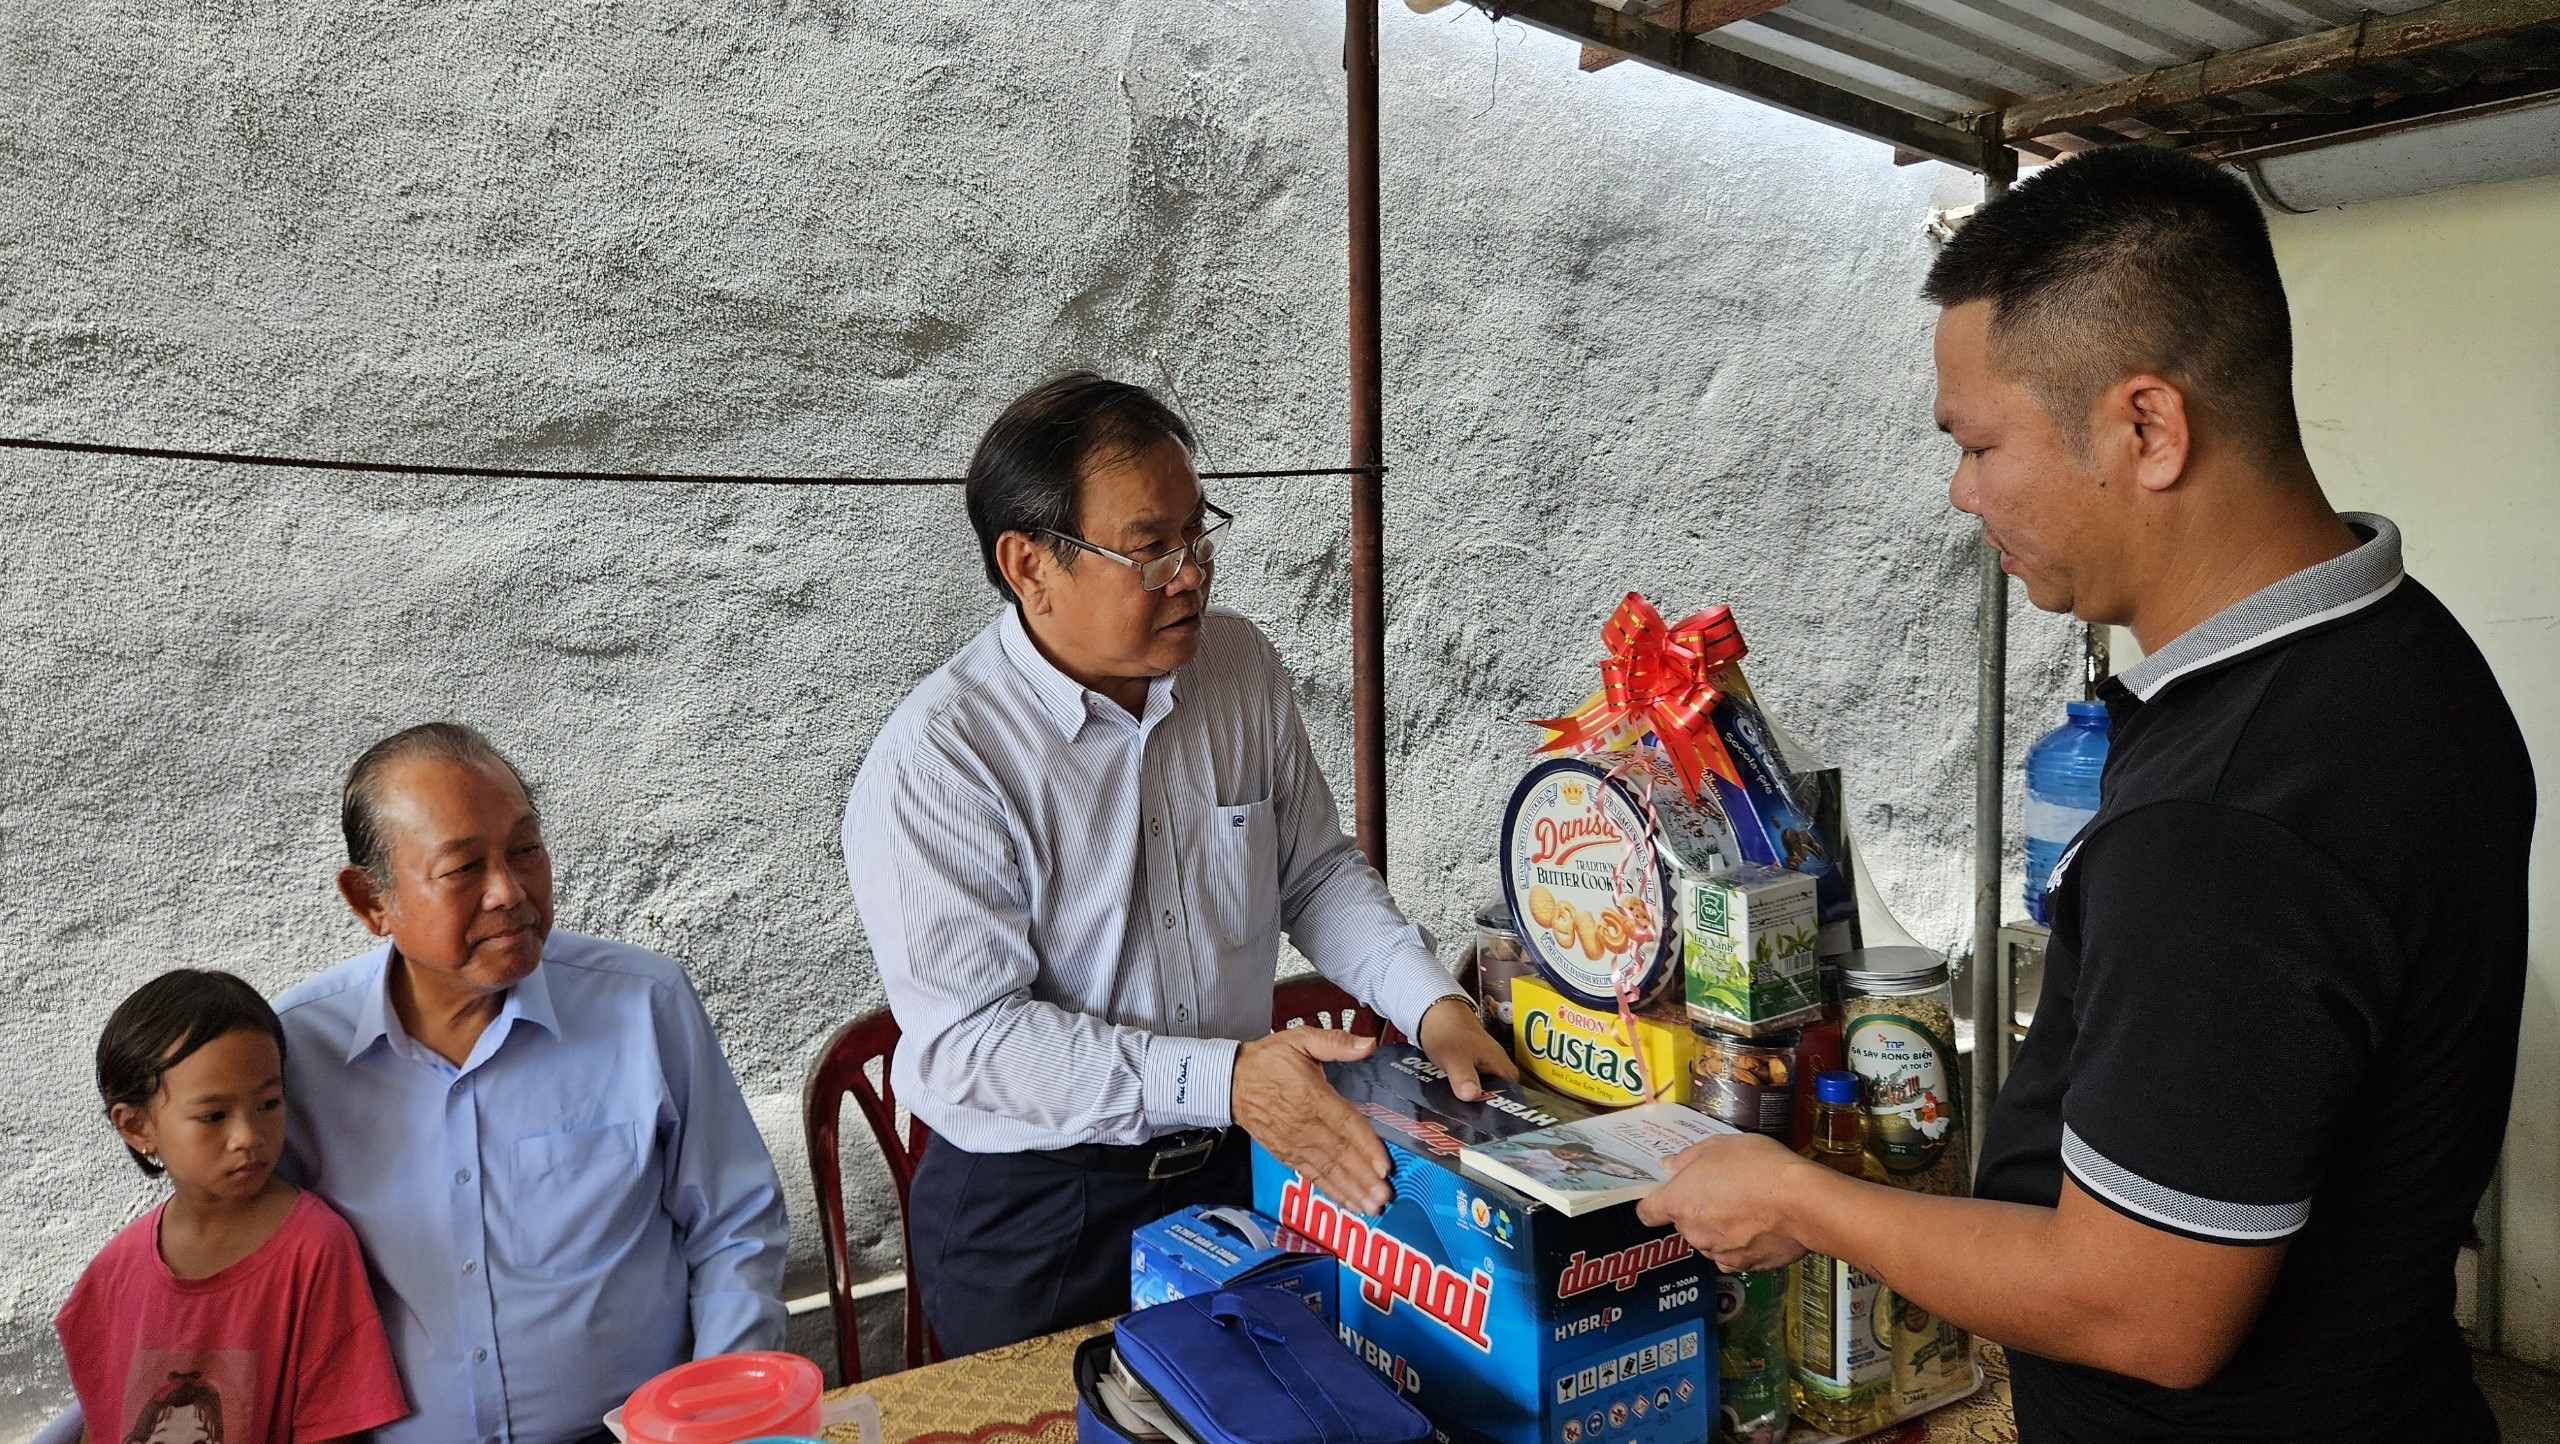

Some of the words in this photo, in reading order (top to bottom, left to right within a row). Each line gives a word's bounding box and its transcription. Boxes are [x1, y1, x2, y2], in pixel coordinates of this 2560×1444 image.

[1604, 796, 1637, 843] PENHAGEN
[1531, 806, 1622, 865] Danisa
[1537, 867, 1579, 888] BUTTER
[1581, 871, 1634, 894] COOKES
[1704, 906, 1717, 916] TEA
[1566, 1010, 1606, 1034] ORION
[1524, 1009, 1644, 1095] Custas
[1881, 1052, 1910, 1060] RONG
[1279, 1169, 1493, 1355] dongnai
[1658, 1287, 1699, 1312] N100
